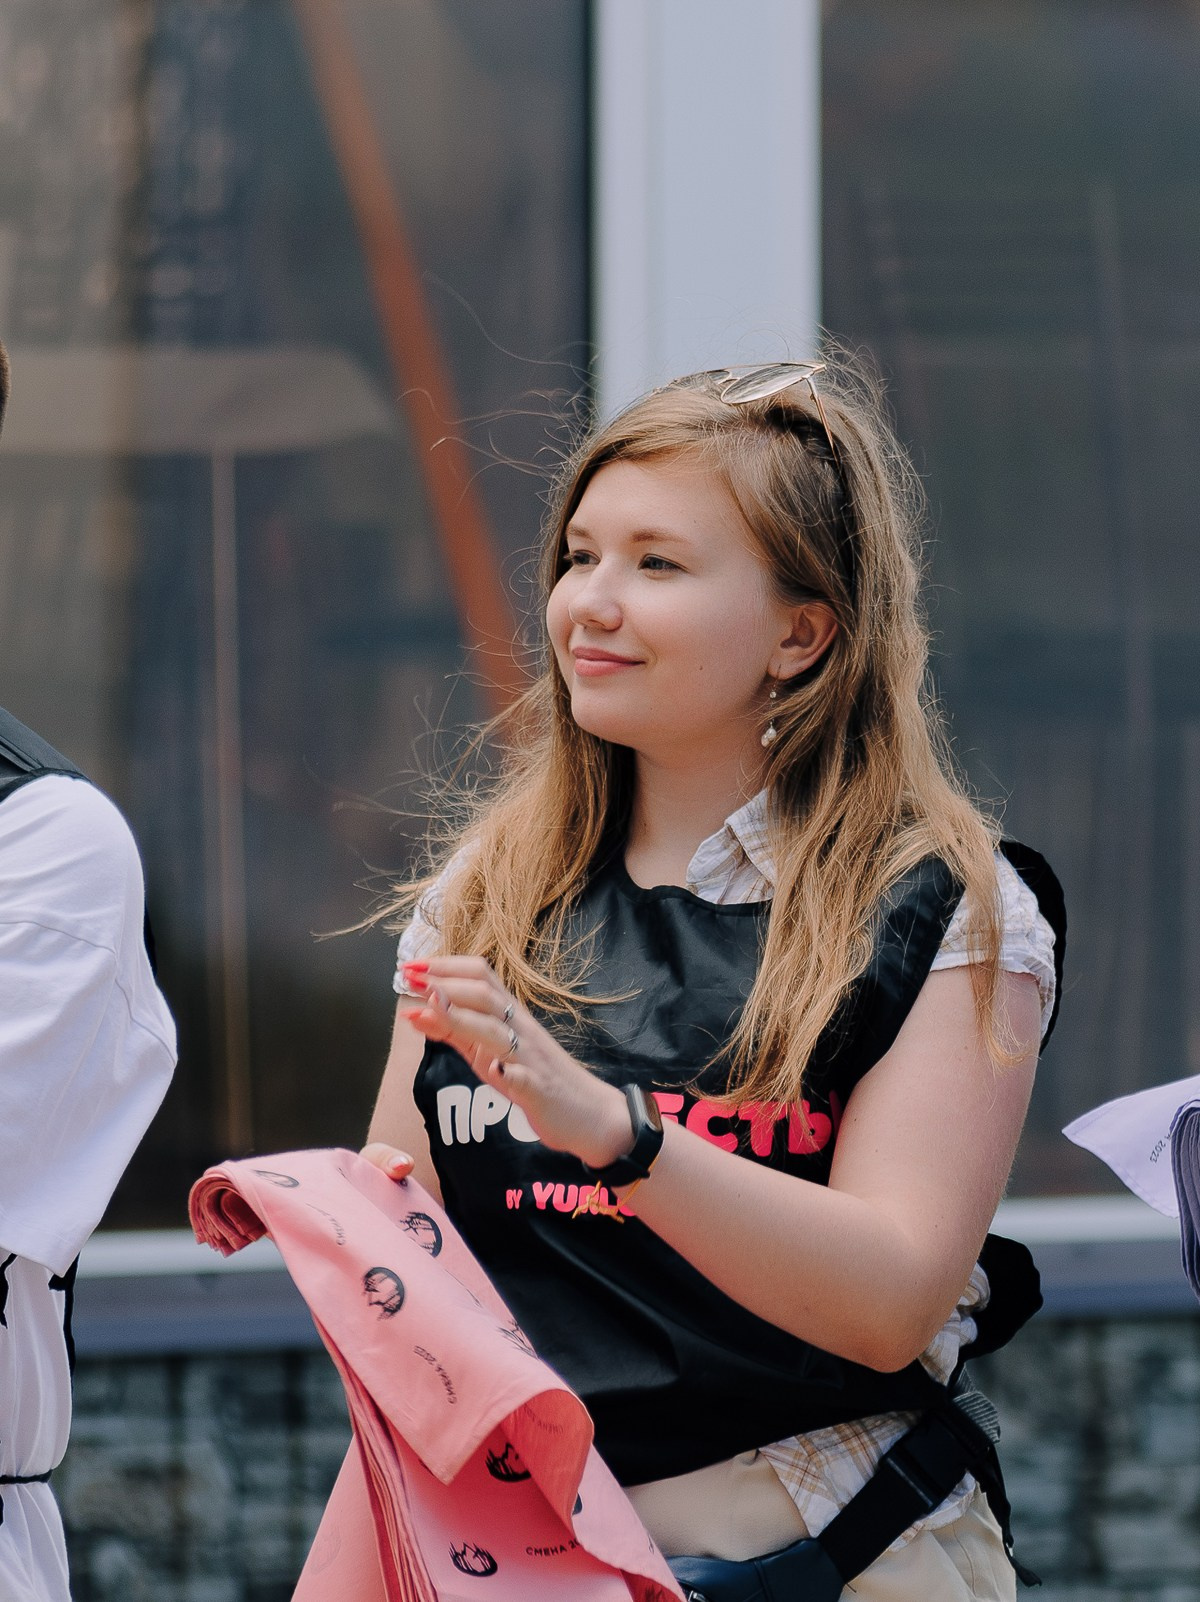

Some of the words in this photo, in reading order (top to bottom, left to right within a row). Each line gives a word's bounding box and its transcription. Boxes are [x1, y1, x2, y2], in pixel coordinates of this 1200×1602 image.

[506, 1189, 523, 1210] BY
[532, 1181, 637, 1217] YURL
[525, 1544, 568, 1557] СМЕНА
